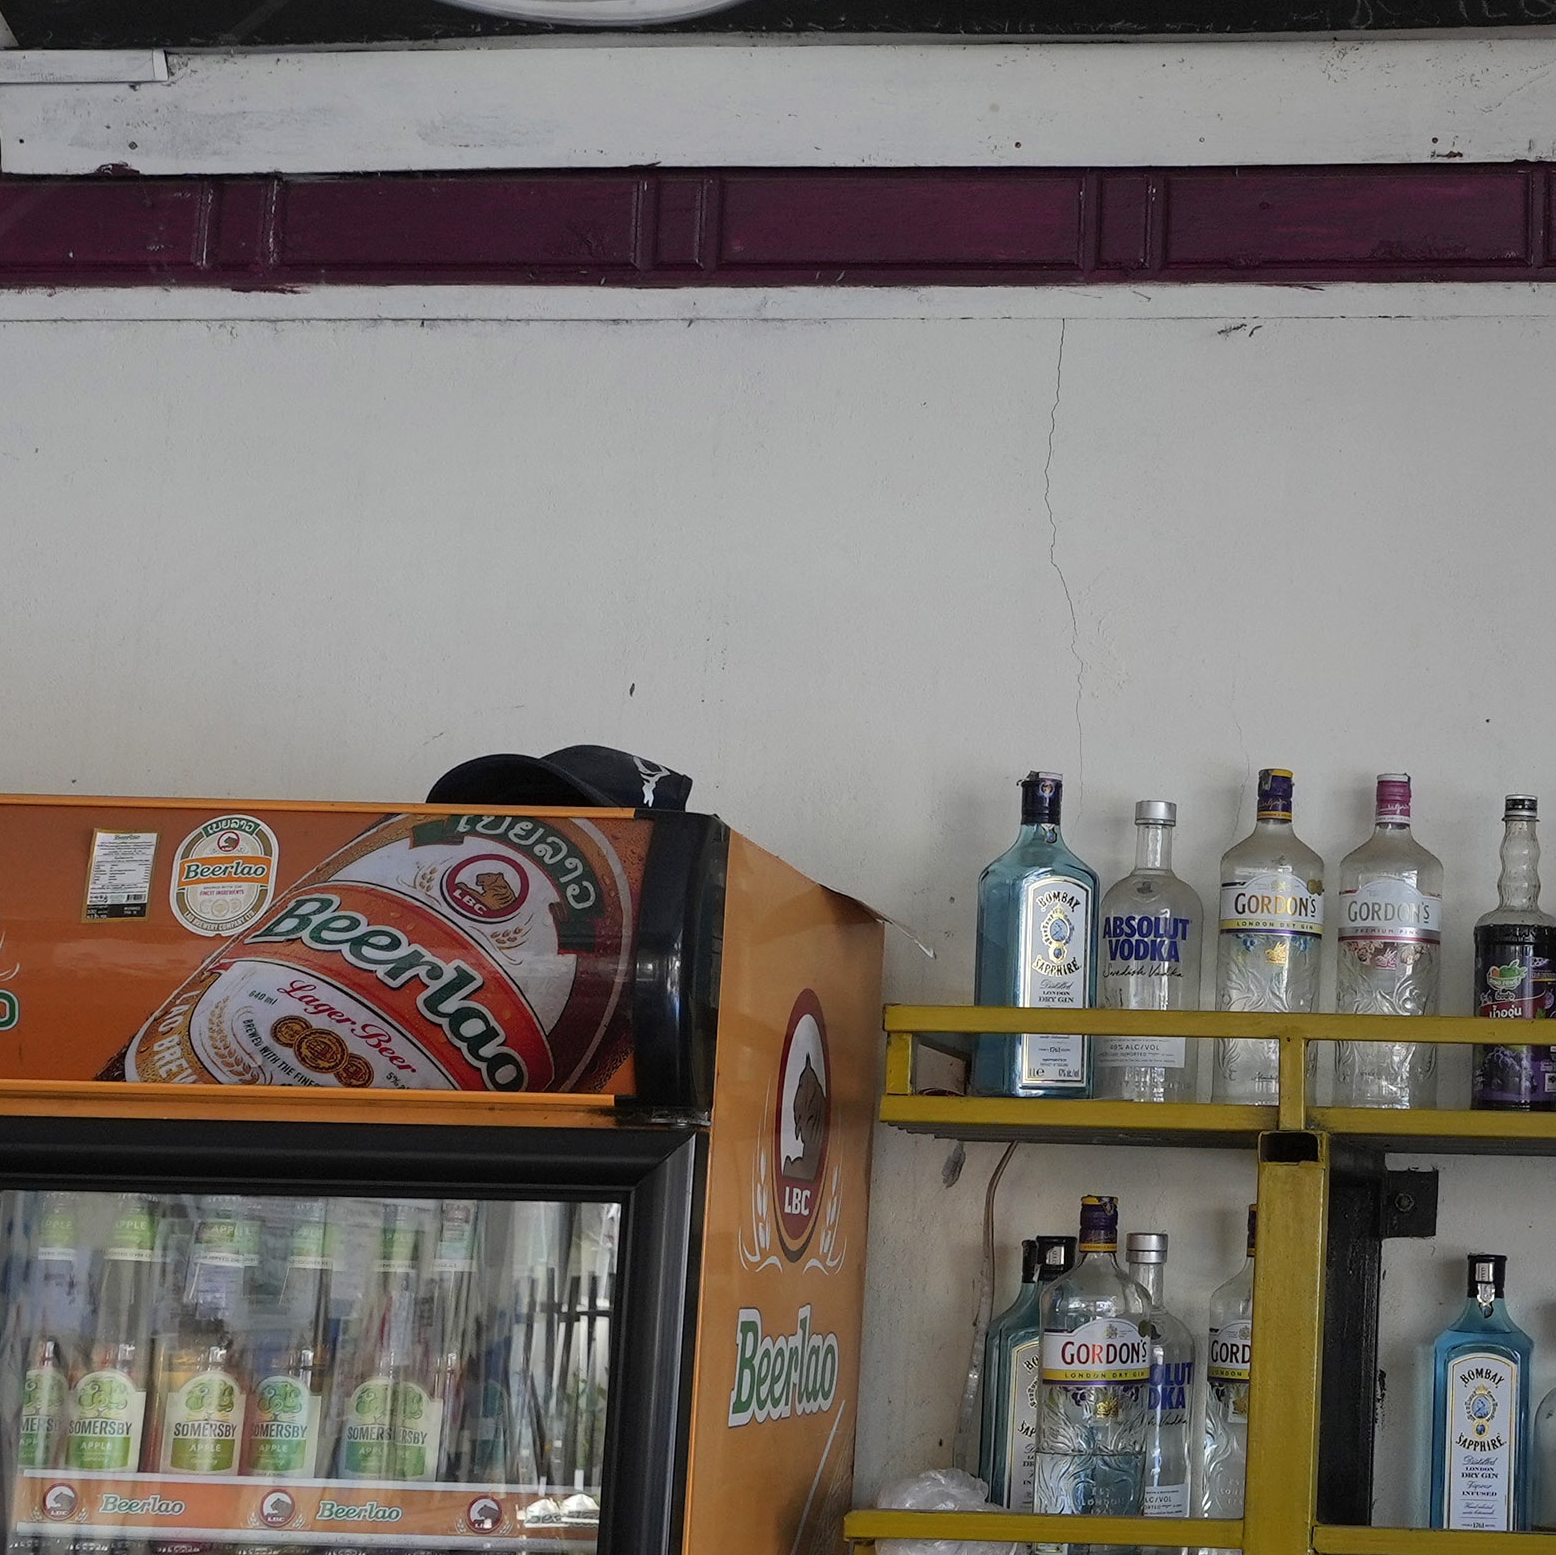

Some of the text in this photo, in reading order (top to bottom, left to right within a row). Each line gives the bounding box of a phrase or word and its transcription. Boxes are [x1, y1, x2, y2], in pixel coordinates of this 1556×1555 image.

[182, 858, 267, 882] Beerlao
[453, 888, 488, 914] LBC
[1233, 892, 1317, 918] GORDON'S
[1103, 916, 1190, 940] ABSOLUT
[1108, 939, 1181, 963] VODKA
[244, 893, 533, 1093] Beerlao
[276, 978, 417, 1076] Lager Beer
[784, 1185, 812, 1218] LBC
[1060, 1338, 1149, 1366] GORDON'S
[729, 1304, 840, 1428] Beerlao
[1459, 1367, 1505, 1388] BOMBAY
[68, 1416, 134, 1438] SOMERSBY
[172, 1420, 239, 1442] SOMERSBY
[188, 1442, 222, 1454] APPLE
[1455, 1431, 1507, 1452] SAPPHIRE
[97, 1493, 187, 1518] Beerlao
[314, 1499, 403, 1524] Beerlao
